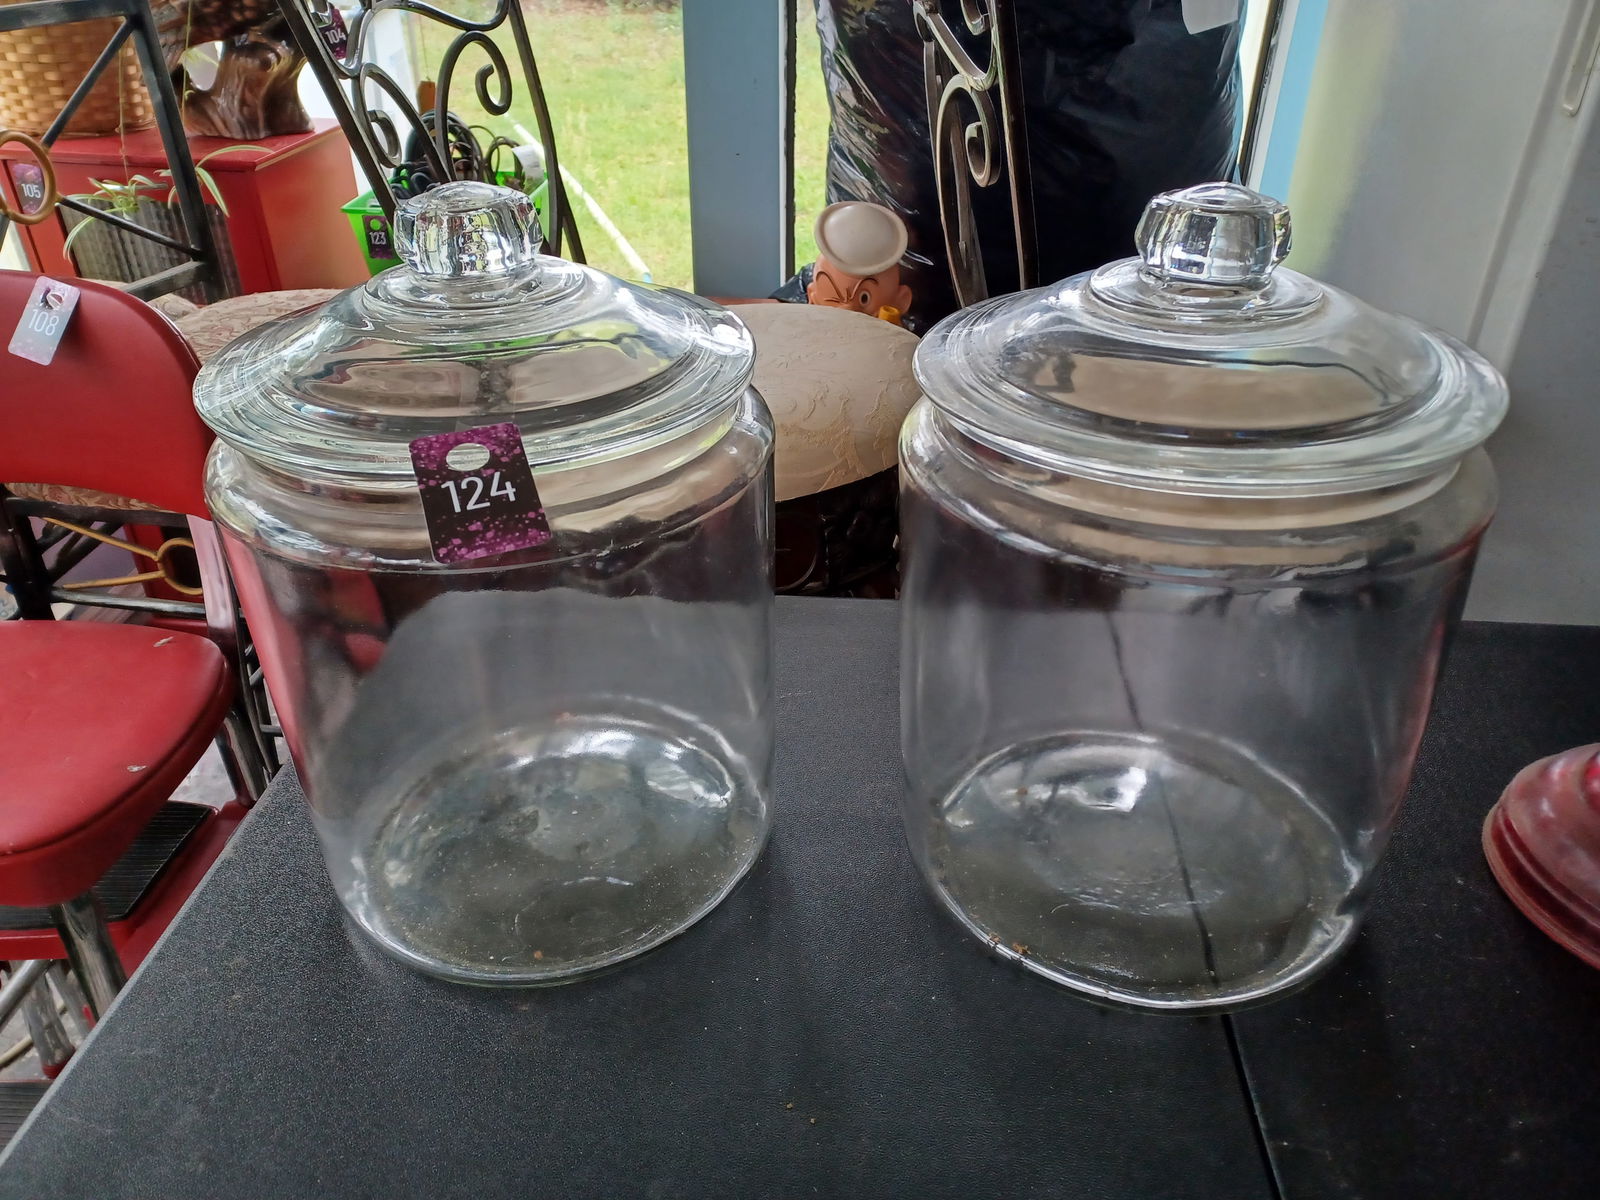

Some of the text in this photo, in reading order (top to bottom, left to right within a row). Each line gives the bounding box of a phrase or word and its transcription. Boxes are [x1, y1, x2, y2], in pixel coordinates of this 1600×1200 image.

[325, 28, 347, 44] 104
[21, 183, 41, 199] 105
[369, 231, 387, 245] 123
[28, 308, 60, 336] 108
[440, 471, 517, 513] 124
